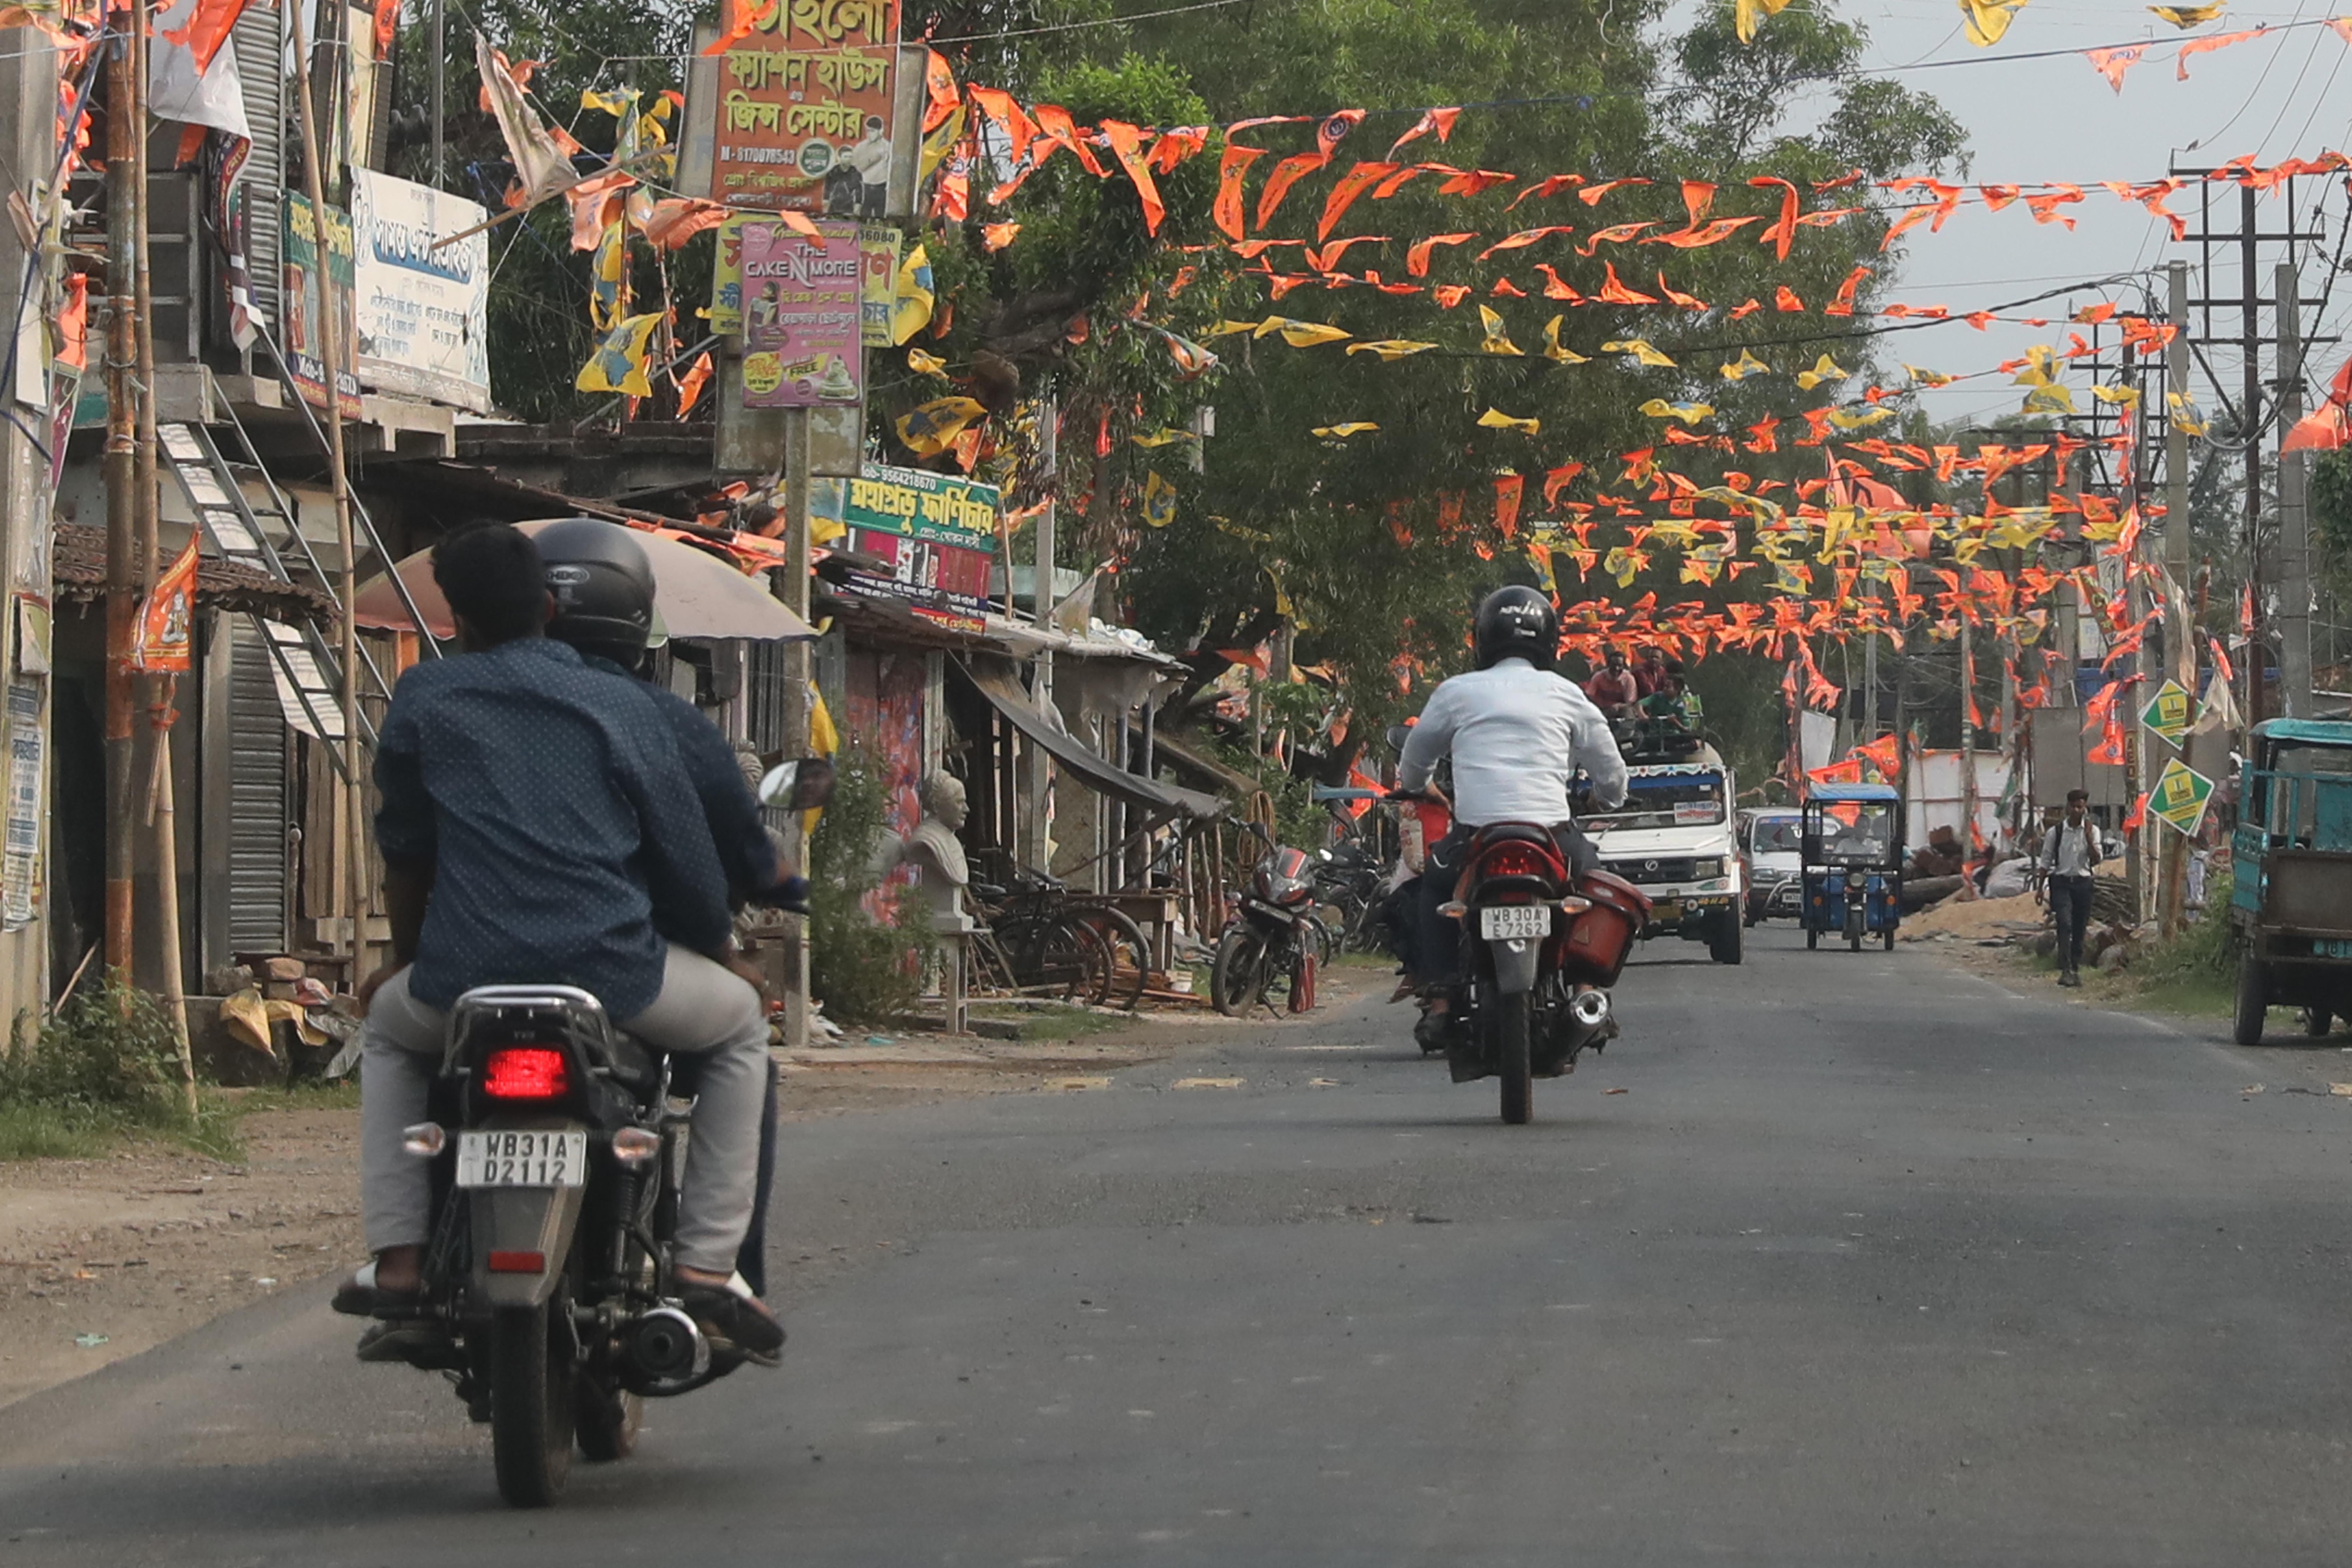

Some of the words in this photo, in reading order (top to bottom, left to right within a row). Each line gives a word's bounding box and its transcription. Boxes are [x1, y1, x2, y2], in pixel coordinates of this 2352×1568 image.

[812, 43, 890, 96] হাউস
[787, 95, 865, 139] সেন্টার
[746, 262, 789, 277] CAKE
[810, 260, 856, 277] MORE
[486, 1133, 567, 1157] WB31A
[484, 1159, 565, 1183] D2112
